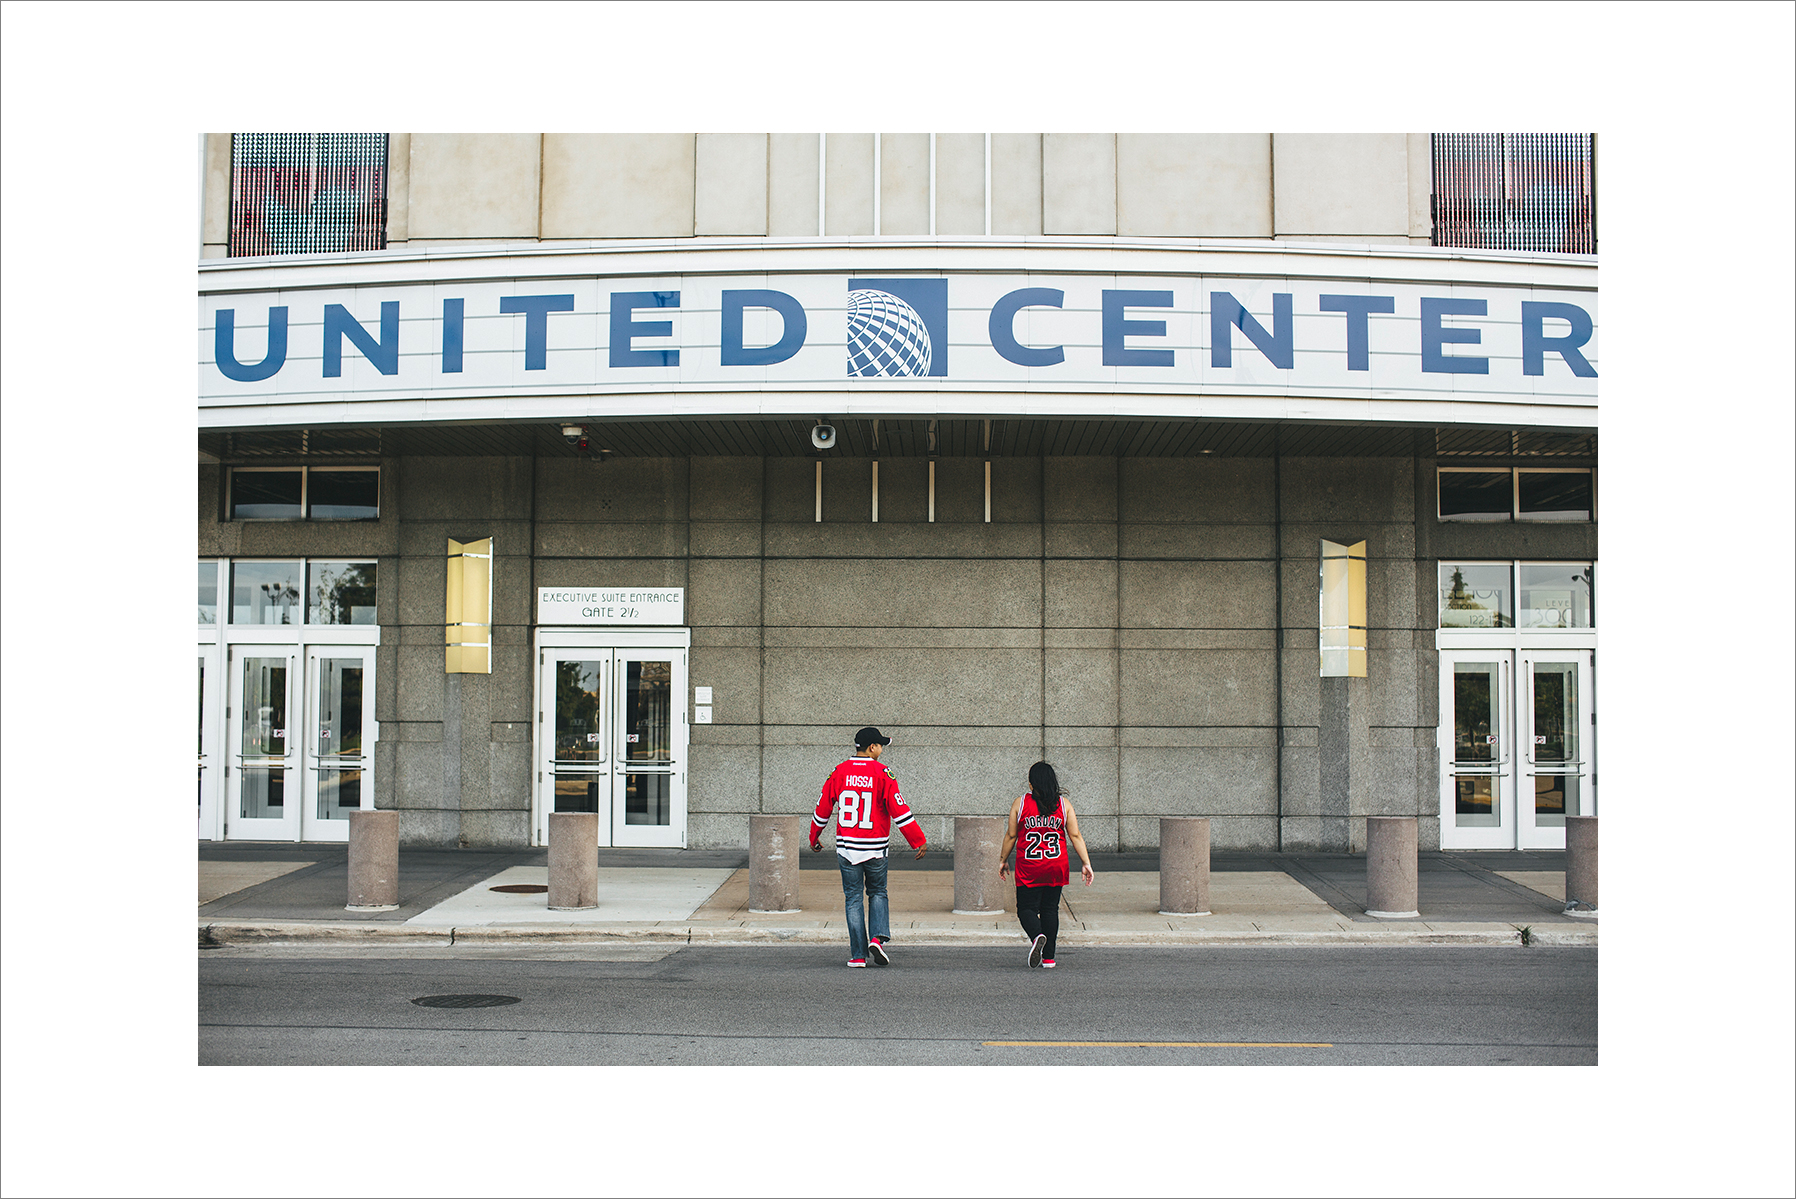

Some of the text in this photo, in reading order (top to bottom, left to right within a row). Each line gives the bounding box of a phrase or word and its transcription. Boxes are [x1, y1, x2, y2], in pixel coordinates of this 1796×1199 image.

[215, 287, 1598, 382] UNITED CENTER
[543, 593, 679, 603] EXECUTIVE SUITE ENTRANCE
[582, 607, 614, 618] GATE
[845, 775, 873, 788] HOSSA
[838, 790, 873, 829] 81
[1024, 815, 1062, 829] JORDAN
[1025, 832, 1061, 859] 23
